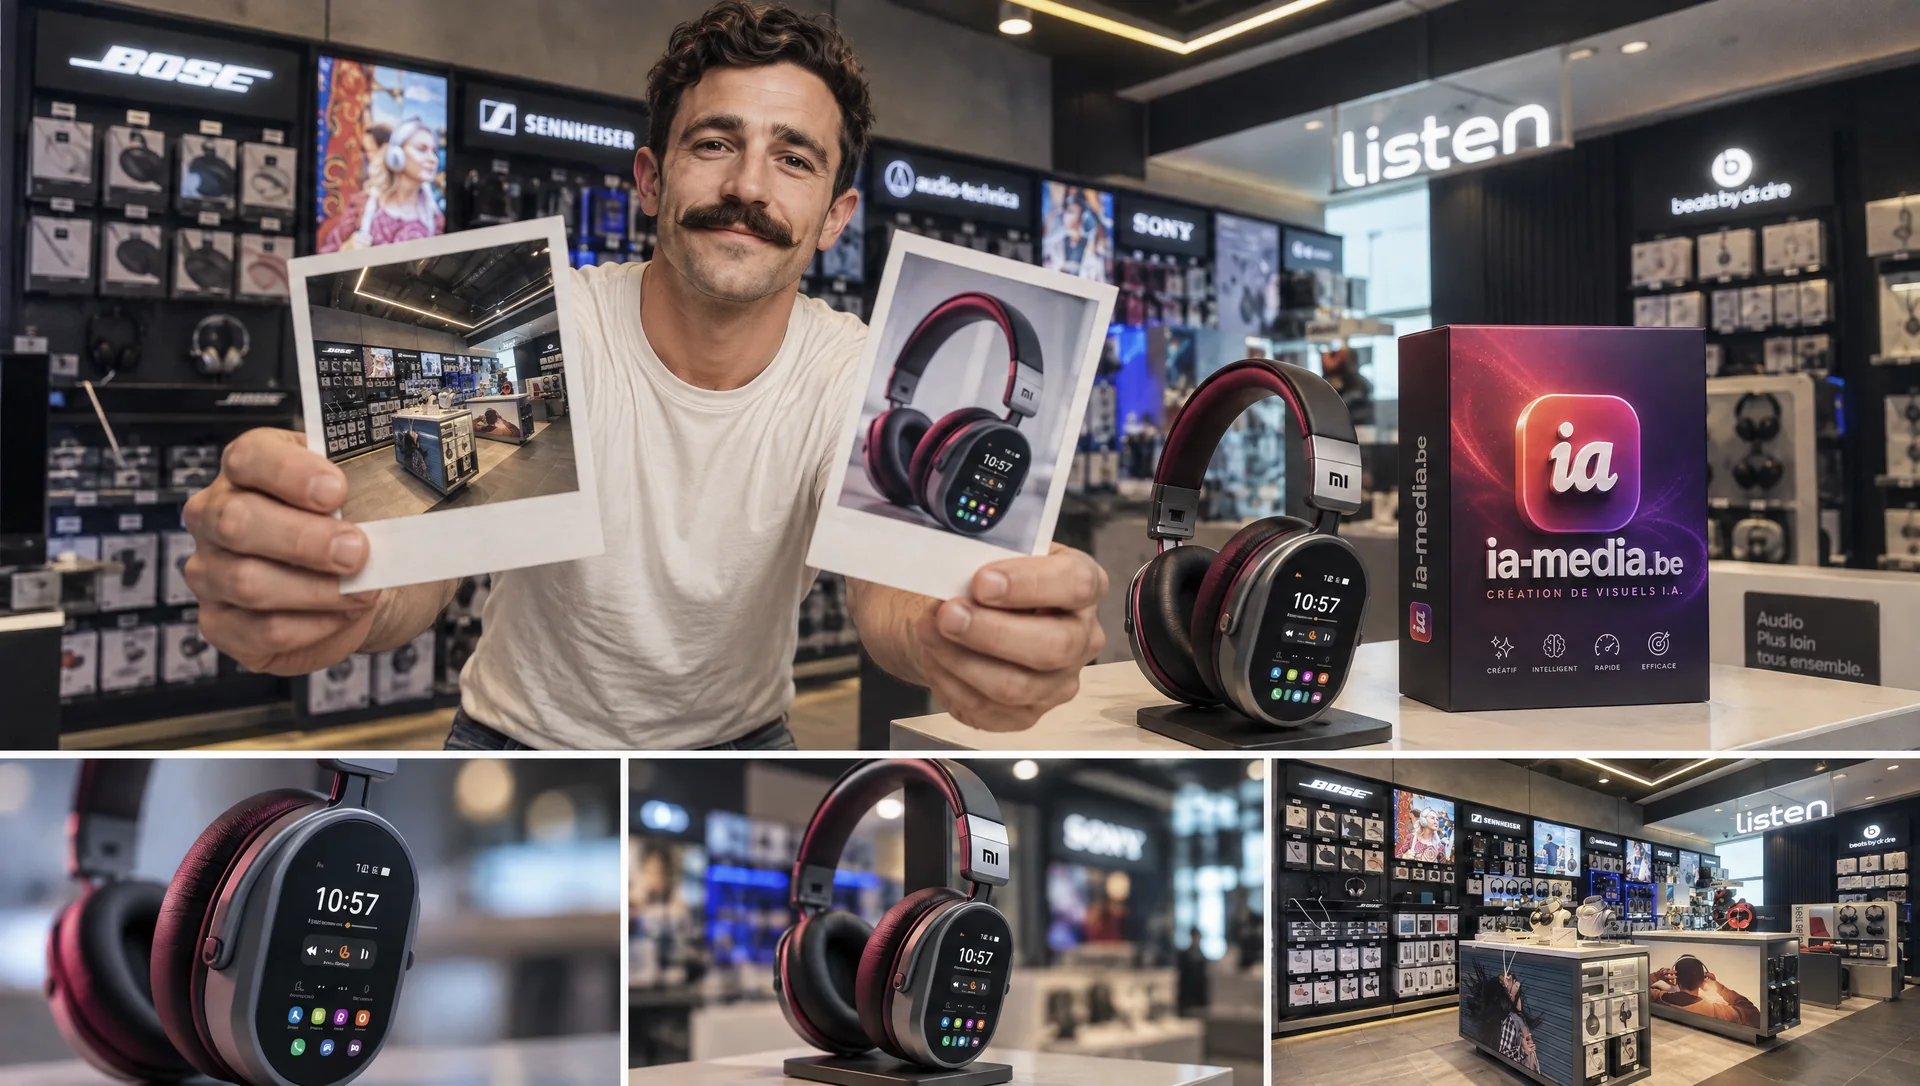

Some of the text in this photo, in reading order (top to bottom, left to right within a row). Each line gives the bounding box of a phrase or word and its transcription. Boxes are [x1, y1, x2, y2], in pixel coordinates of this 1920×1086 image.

[69, 45, 273, 93] BOSE
[524, 114, 635, 150] SENNHEISER
[1342, 104, 1550, 187] listen
[915, 175, 1020, 210] audio-technica
[1671, 193, 1719, 216] beats
[1718, 190, 1742, 209] by
[1132, 212, 1195, 242] SONY
[983, 453, 1013, 473] 10:57
[1549, 421, 1619, 494] ia
[1412, 435, 1428, 590] ia-media.be
[1486, 537, 1684, 580] ia-media.be
[1293, 592, 1341, 614] 10:57
[1486, 585, 1683, 599] CRÉATION DE VISUELS I.A.
[1757, 610, 1804, 630] Audio
[1757, 630, 1816, 652] Plus loin
[1486, 666, 1518, 674] CRÉATIF
[1532, 665, 1578, 673] INTELLIGENT
[1641, 662, 1677, 670] EFFICACE
[1757, 650, 1865, 678] tous ensemble.
[1299, 779, 1373, 799] BOSE
[1736, 800, 1828, 833] listen
[1063, 813, 1147, 861] SONY
[316, 886, 380, 916] 10:57
[959, 947, 994, 966] 10:57
